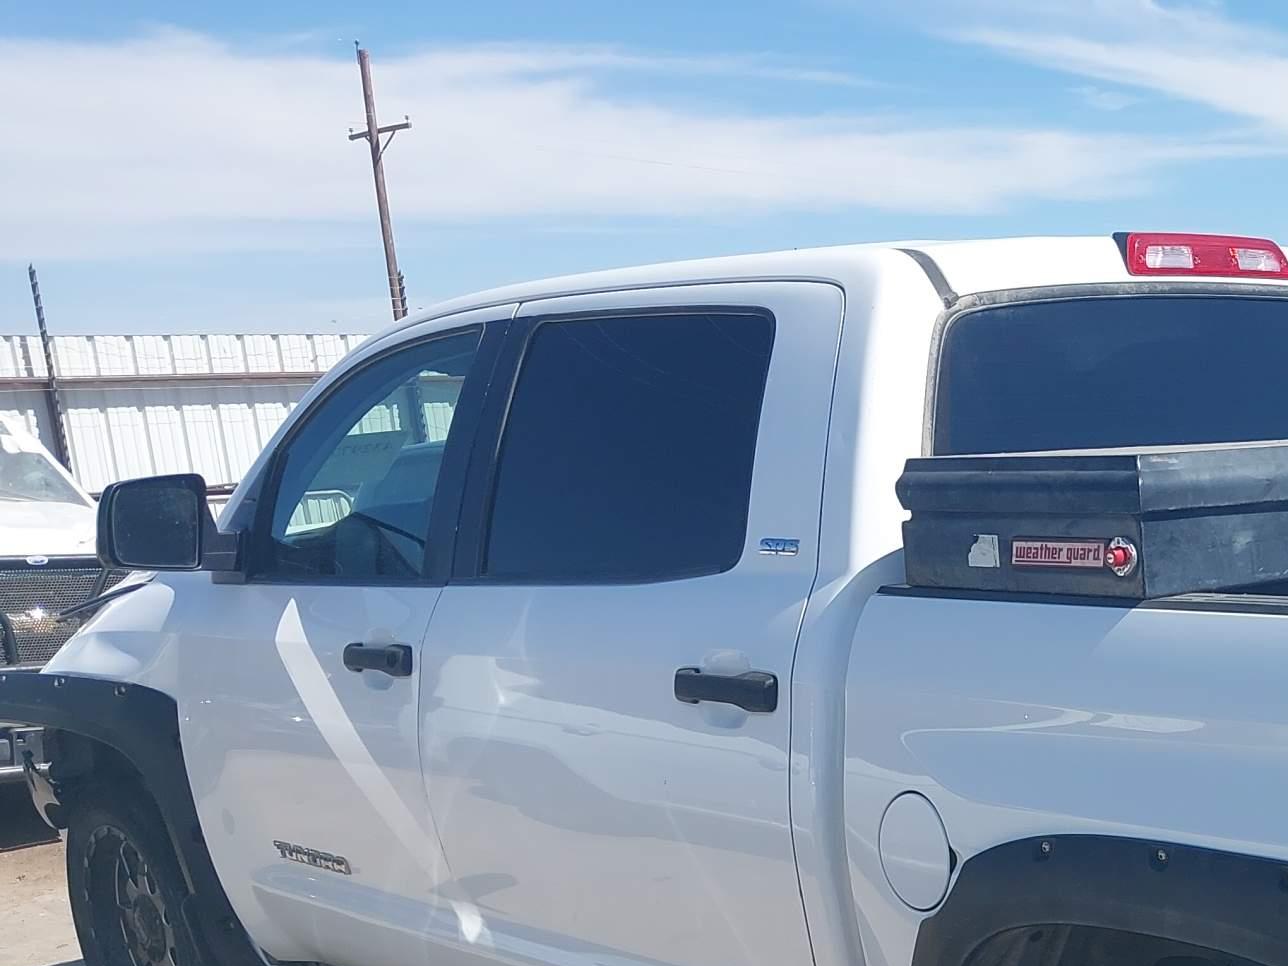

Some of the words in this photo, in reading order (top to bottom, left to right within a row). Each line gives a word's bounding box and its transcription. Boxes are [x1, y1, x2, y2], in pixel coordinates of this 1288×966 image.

[1014, 543, 1063, 560] weather
[1065, 545, 1102, 565] guard
[272, 839, 352, 875] TUNDRA
